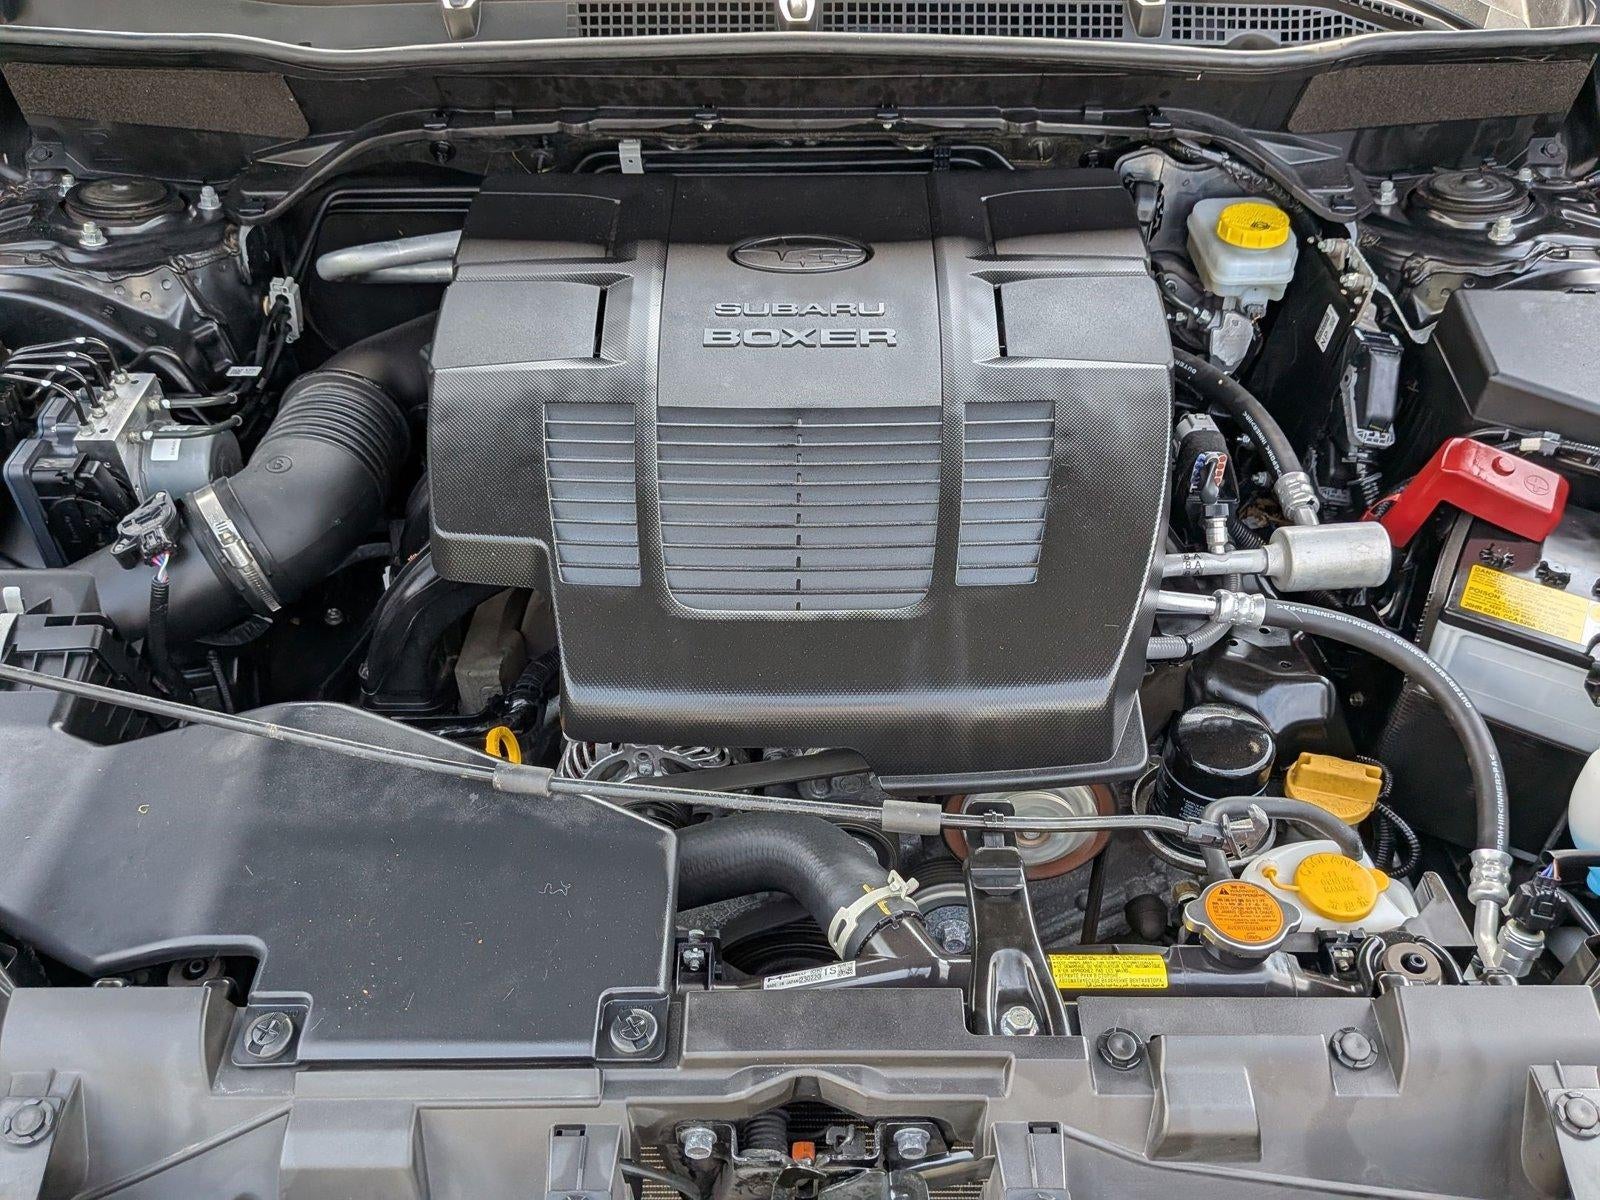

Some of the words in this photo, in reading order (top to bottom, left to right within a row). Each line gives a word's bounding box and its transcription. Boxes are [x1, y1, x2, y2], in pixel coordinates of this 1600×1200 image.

[715, 302, 885, 317] SUBARU
[702, 328, 897, 348] BOXER
[1468, 586, 1500, 600] POISON
